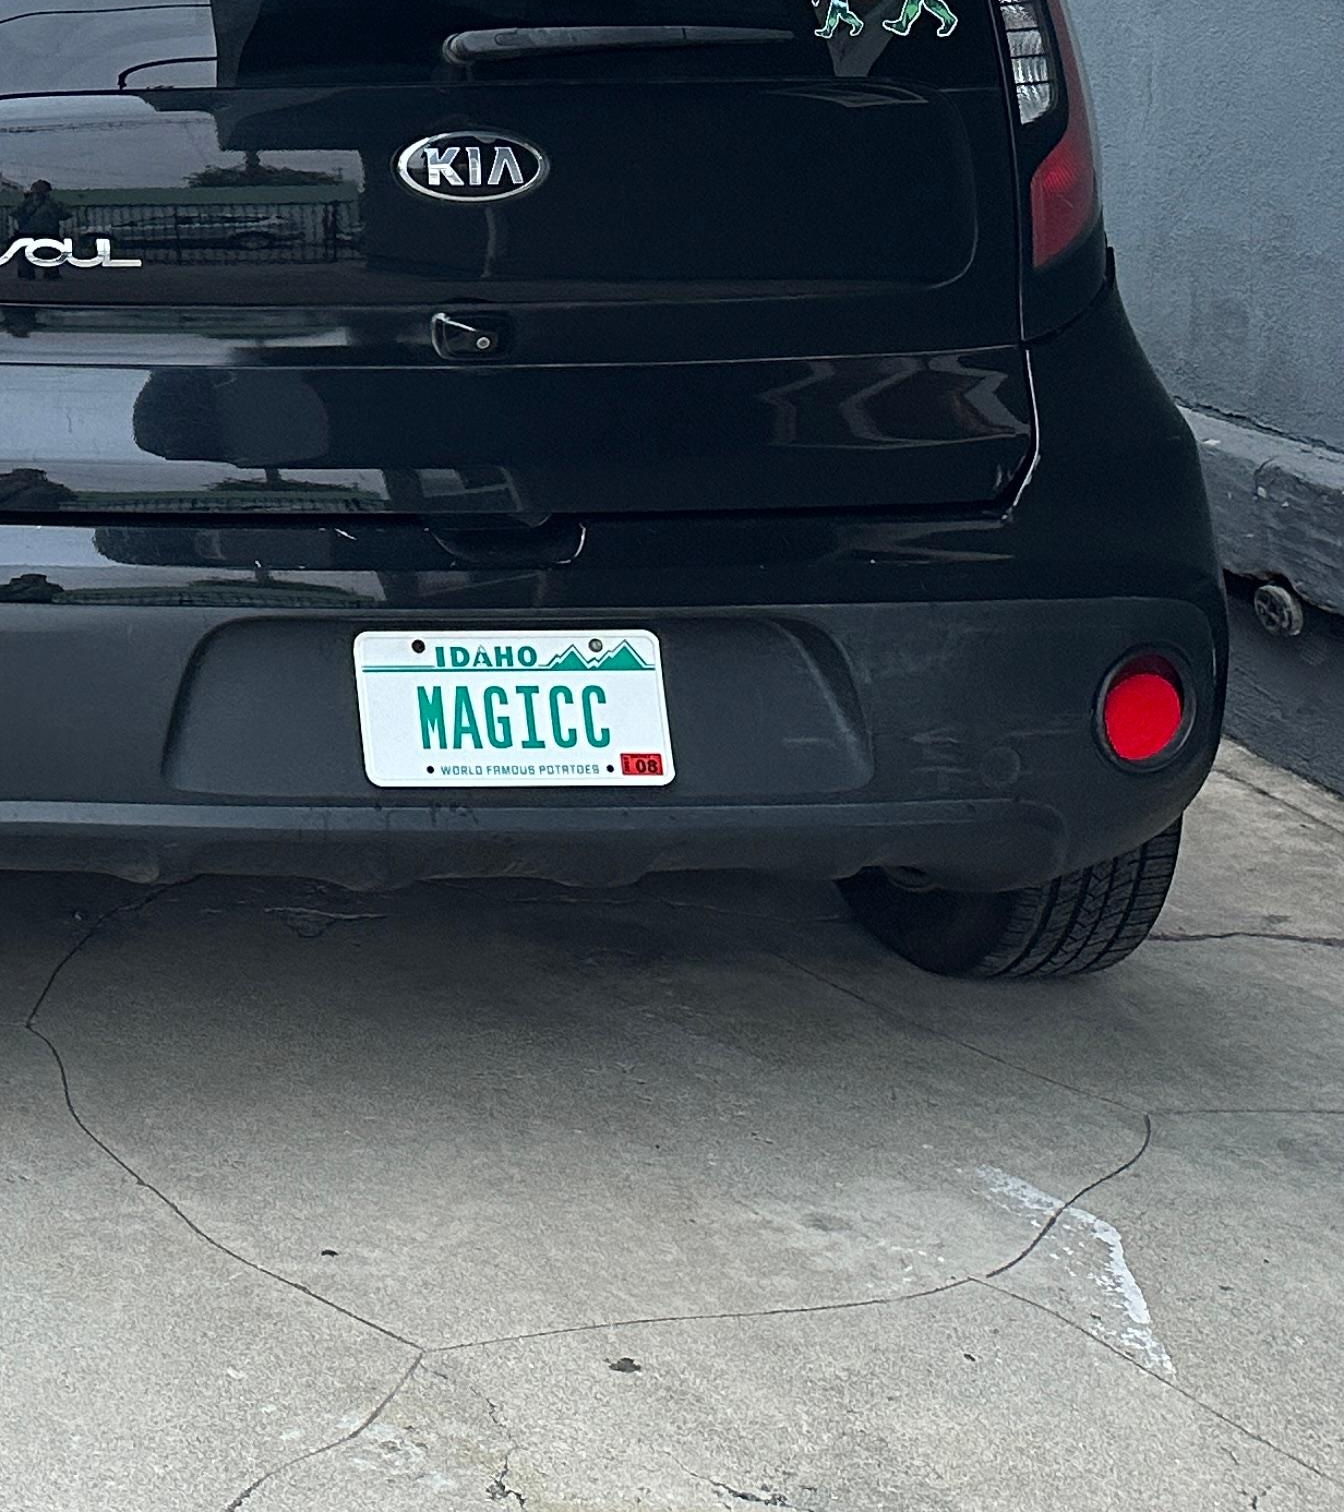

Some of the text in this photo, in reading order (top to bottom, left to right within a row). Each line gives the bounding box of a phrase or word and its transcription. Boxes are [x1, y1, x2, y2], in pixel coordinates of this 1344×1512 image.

[423, 146, 524, 186] KIA
[435, 644, 538, 668] IDAHO
[416, 684, 611, 750] MAGICC
[440, 763, 600, 776] WORLD FAMOUS POTATOES
[635, 758, 659, 774] 08
